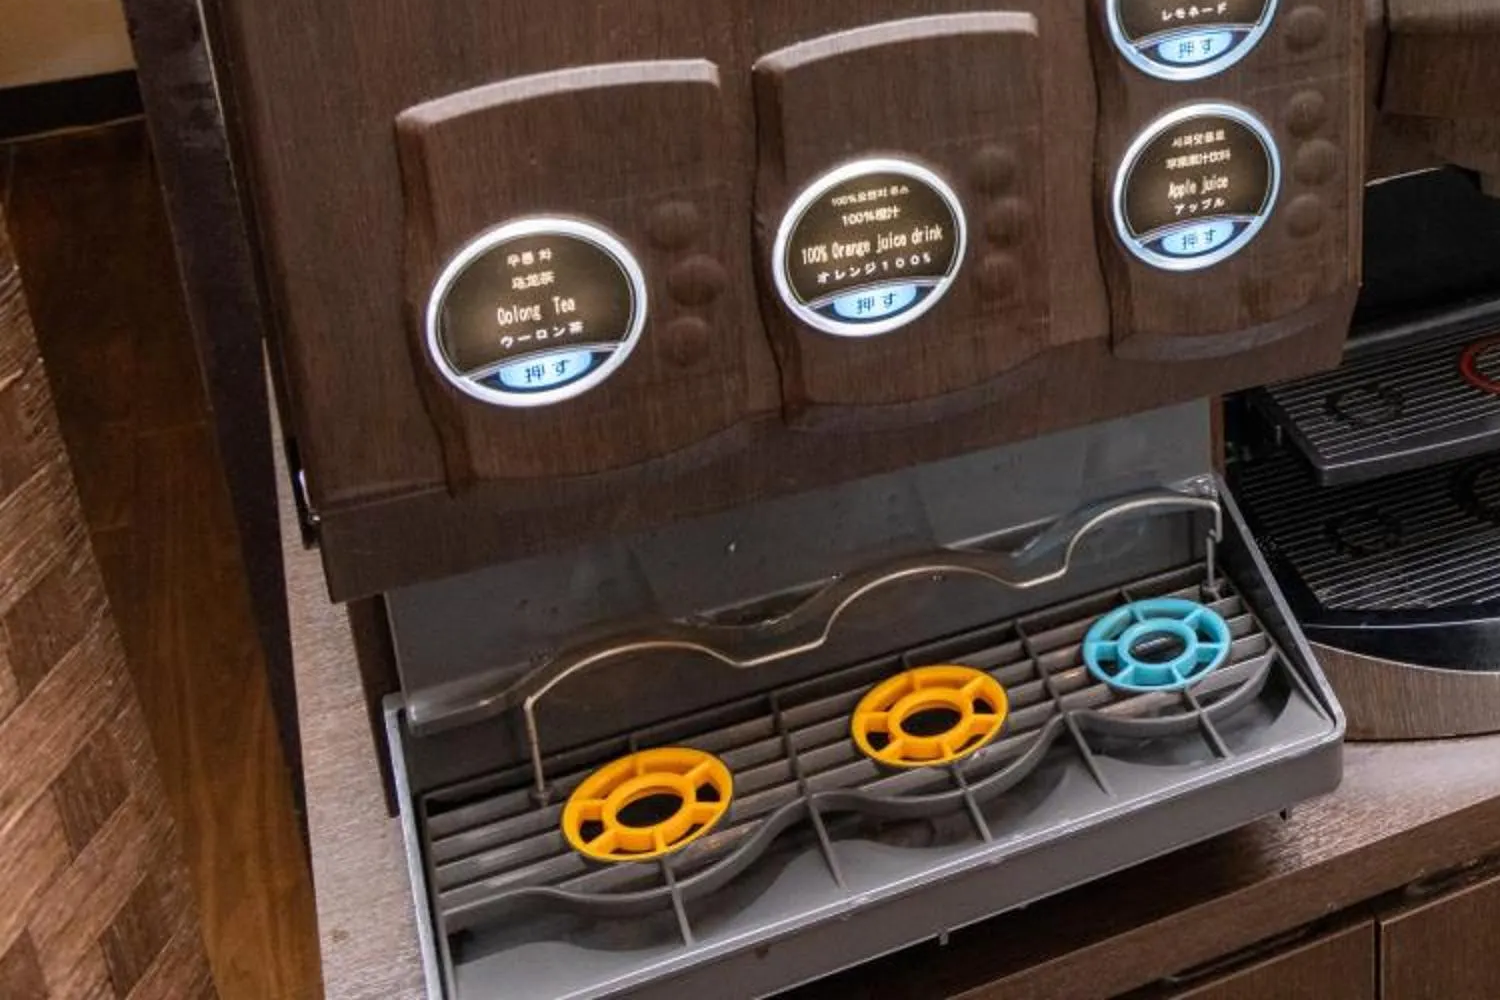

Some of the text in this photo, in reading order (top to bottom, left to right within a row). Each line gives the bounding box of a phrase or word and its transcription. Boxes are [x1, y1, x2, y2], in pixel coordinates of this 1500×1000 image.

[1168, 173, 1229, 200] Apple juice
[801, 224, 943, 265] 100% Orange juice drink
[497, 295, 576, 326] Oolong Tea
[524, 358, 571, 384] 押す
